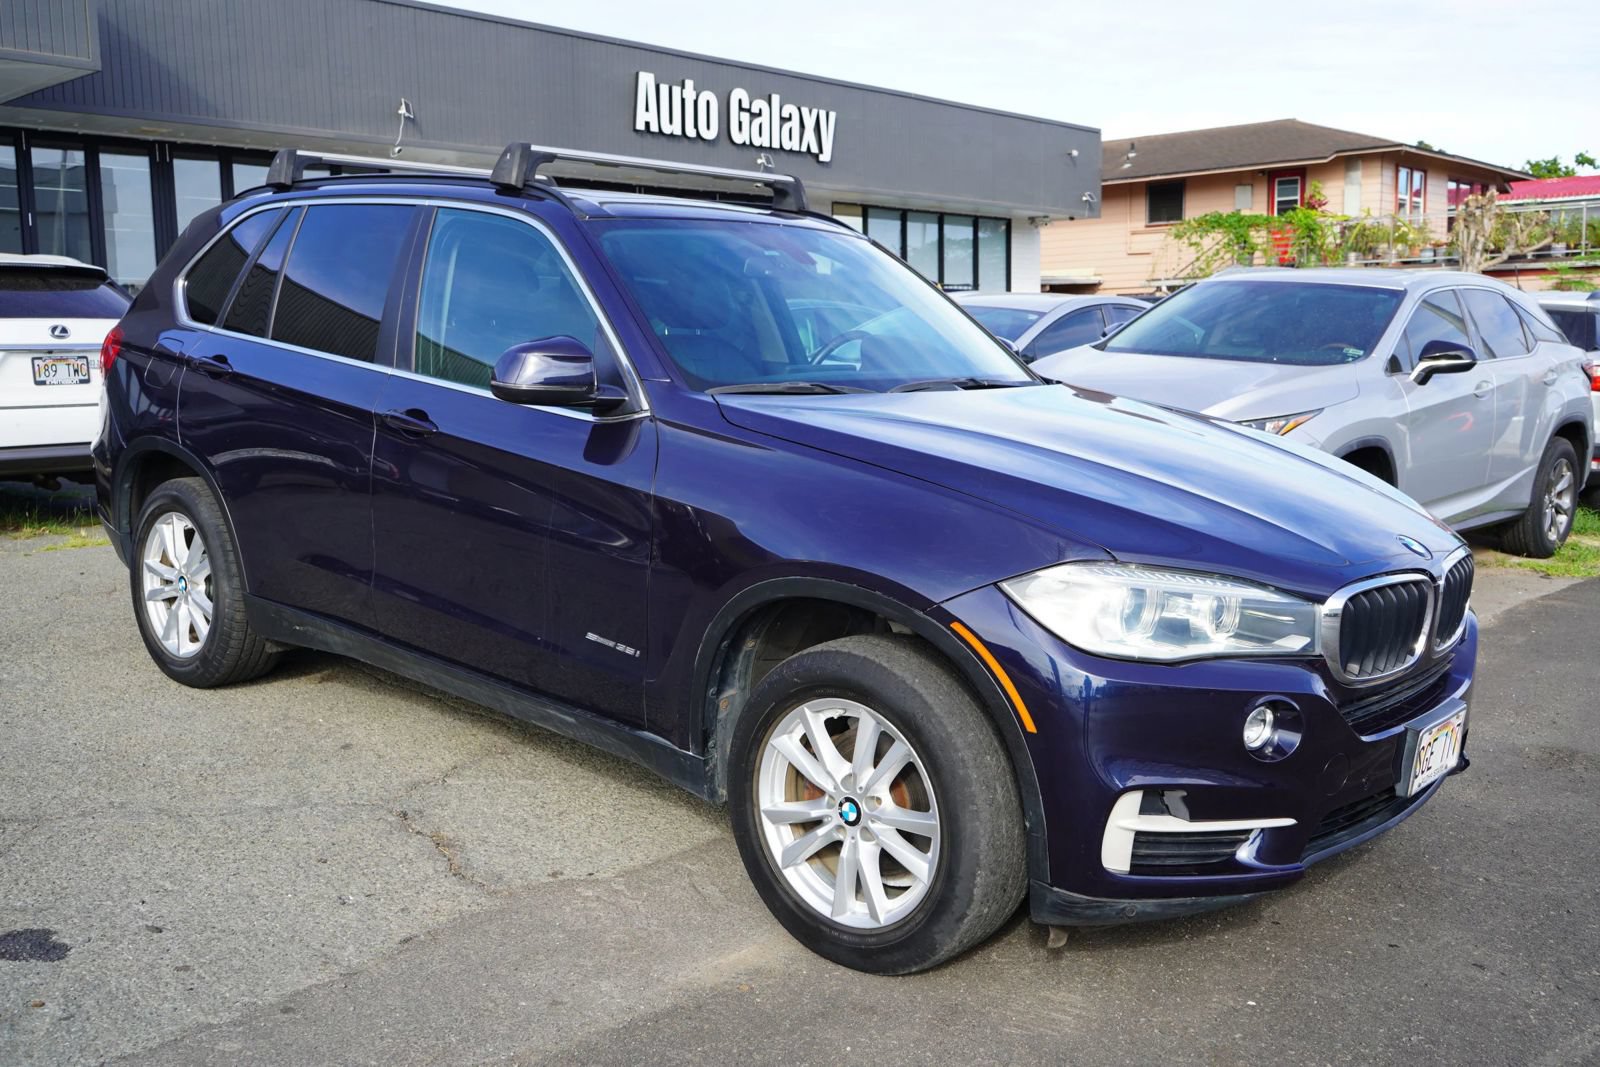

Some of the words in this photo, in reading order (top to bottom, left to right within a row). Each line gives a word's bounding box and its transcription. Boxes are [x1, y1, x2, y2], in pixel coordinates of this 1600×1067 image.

[634, 71, 719, 141] Auto
[729, 87, 837, 163] Galaxy
[36, 363, 58, 379] 189
[65, 363, 87, 378] TWC
